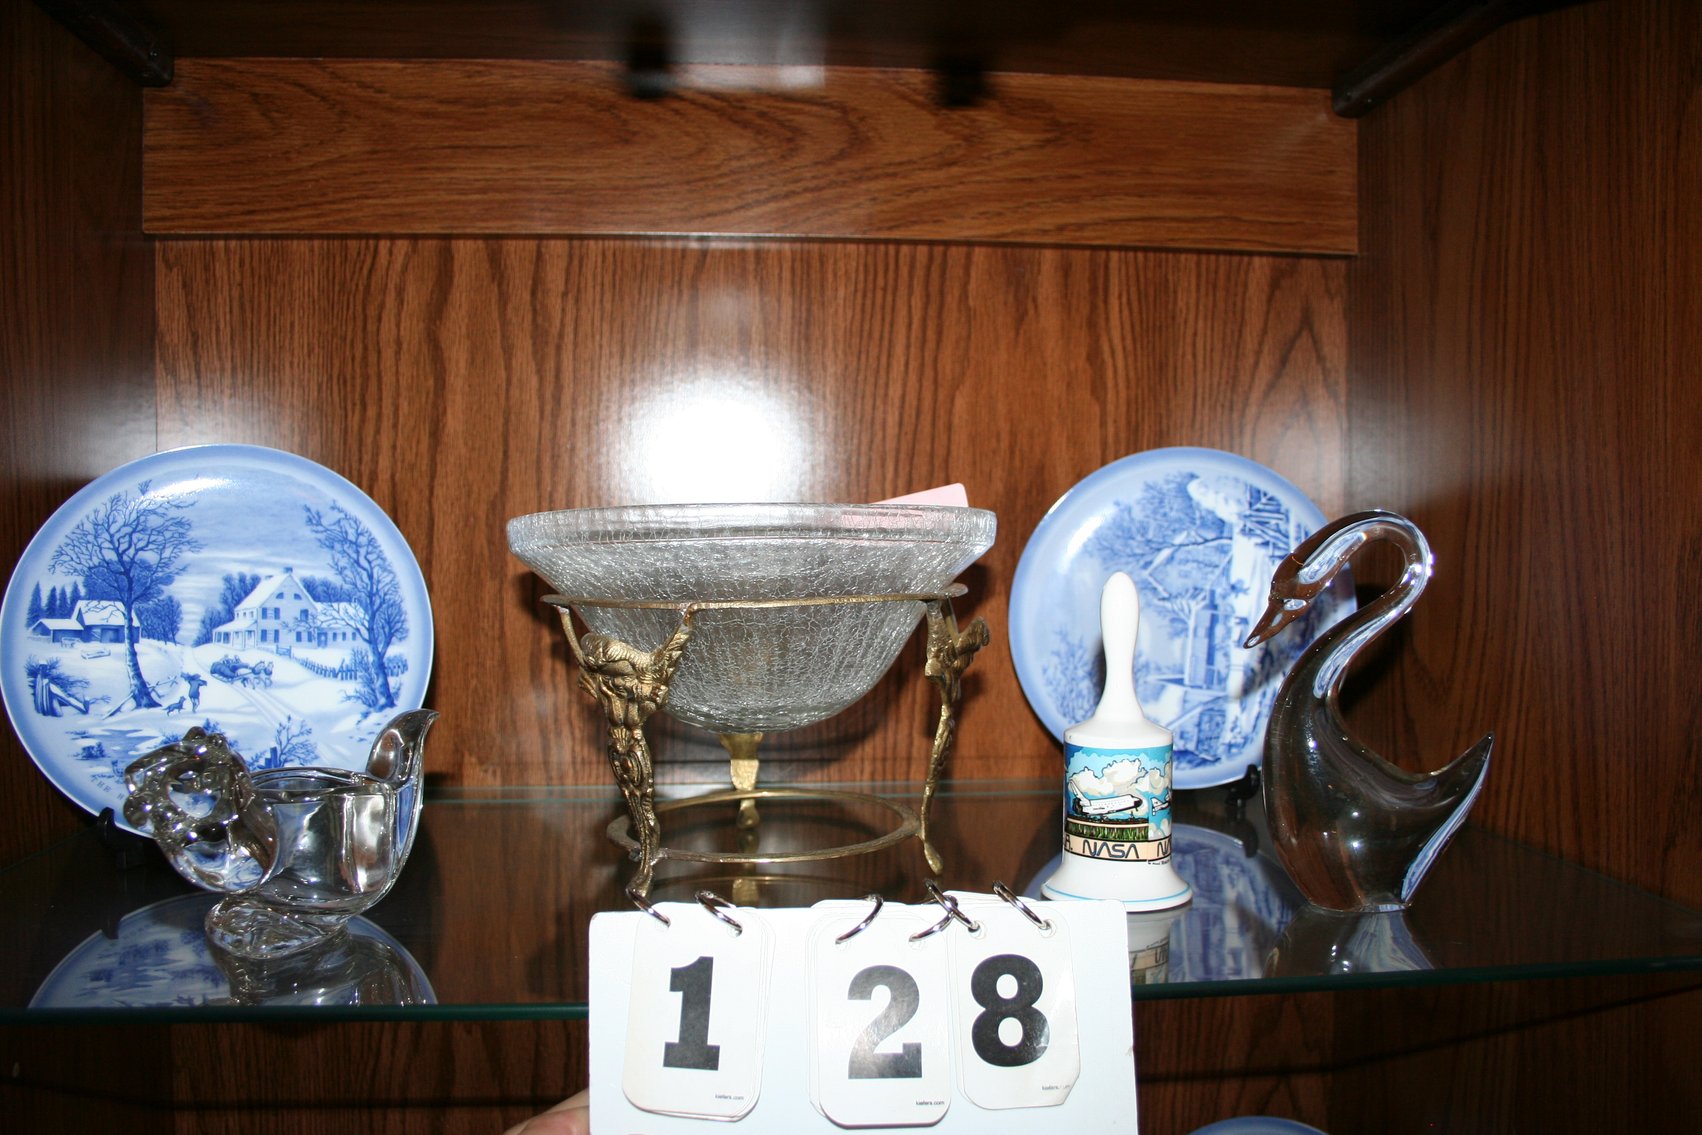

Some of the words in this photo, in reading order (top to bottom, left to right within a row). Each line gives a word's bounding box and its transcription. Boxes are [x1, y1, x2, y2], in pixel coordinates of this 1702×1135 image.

[1082, 839, 1140, 859] NASA
[662, 956, 720, 1071] 1
[848, 964, 922, 1079] 2
[970, 953, 1050, 1067] 8
